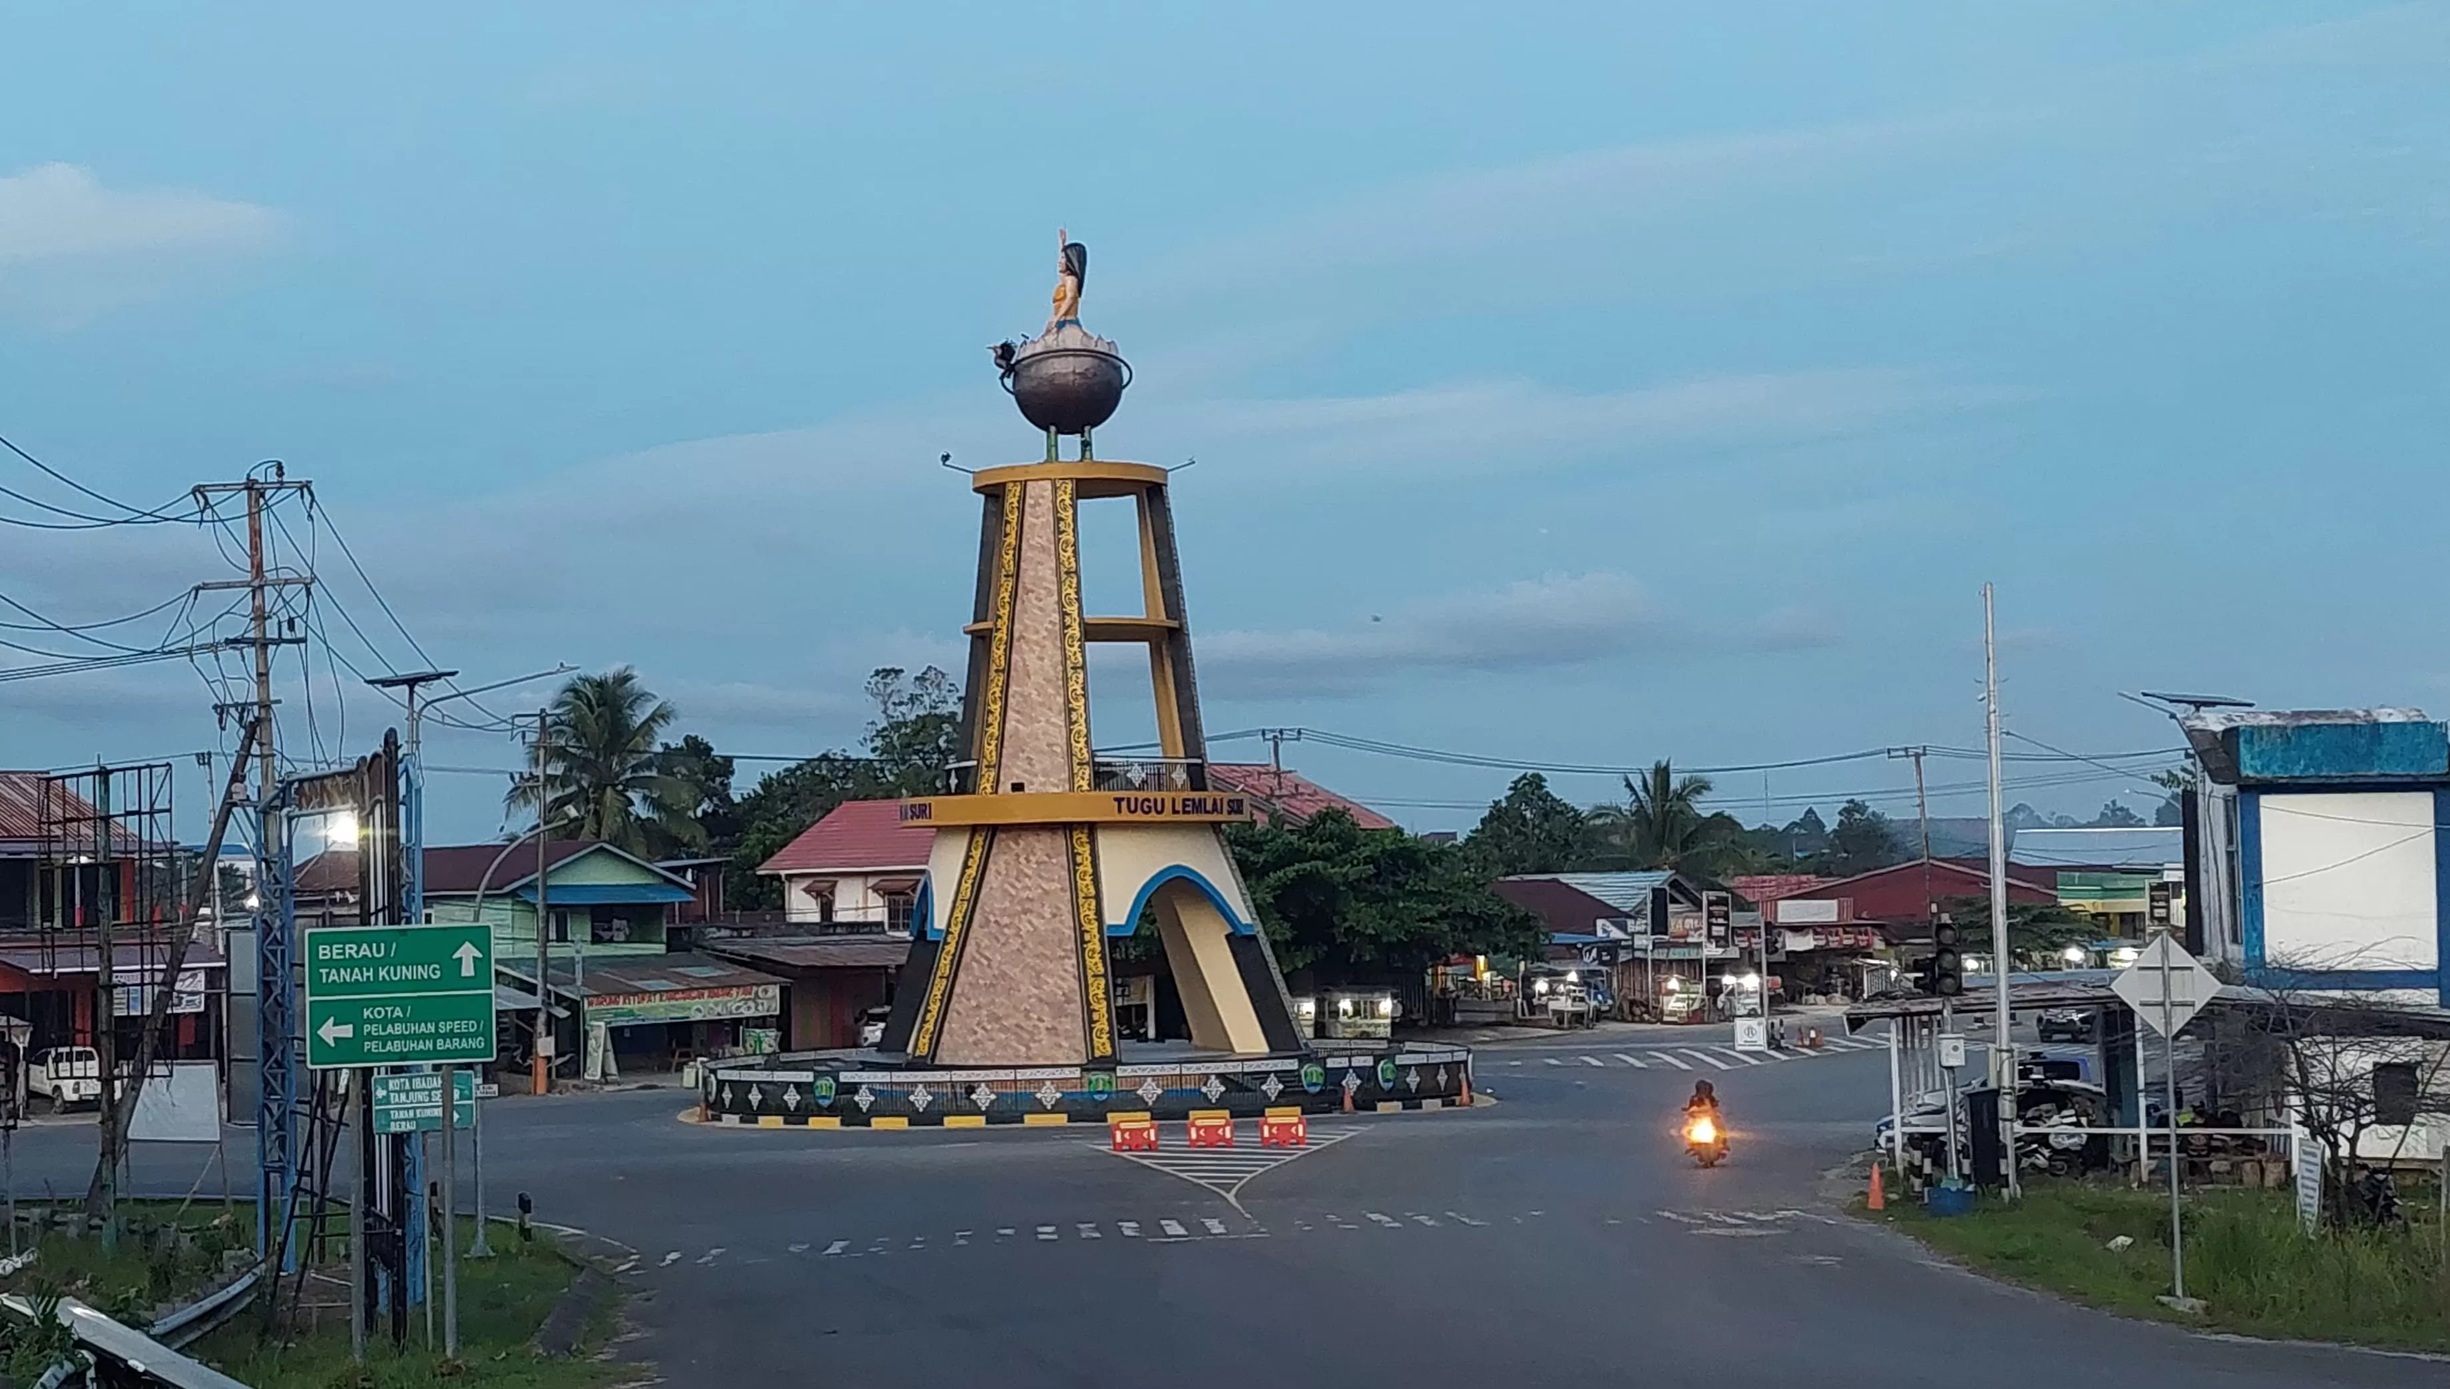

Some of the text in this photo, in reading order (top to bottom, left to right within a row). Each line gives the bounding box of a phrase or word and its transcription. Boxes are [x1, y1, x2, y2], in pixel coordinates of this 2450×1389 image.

[1113, 797, 1165, 815] TUGU
[1171, 797, 1224, 815] LEMLAI
[318, 942, 385, 960] BERAU
[319, 964, 441, 984] TANAH KUNING
[363, 1006, 403, 1020] KOTA
[363, 1022, 435, 1036] PELABUHAN
[438, 1020, 477, 1033] SPEED
[363, 1037, 485, 1053] PELABUHAN BARANG
[388, 1079, 410, 1091] KOTA
[389, 1090, 429, 1104] TANJUNG
